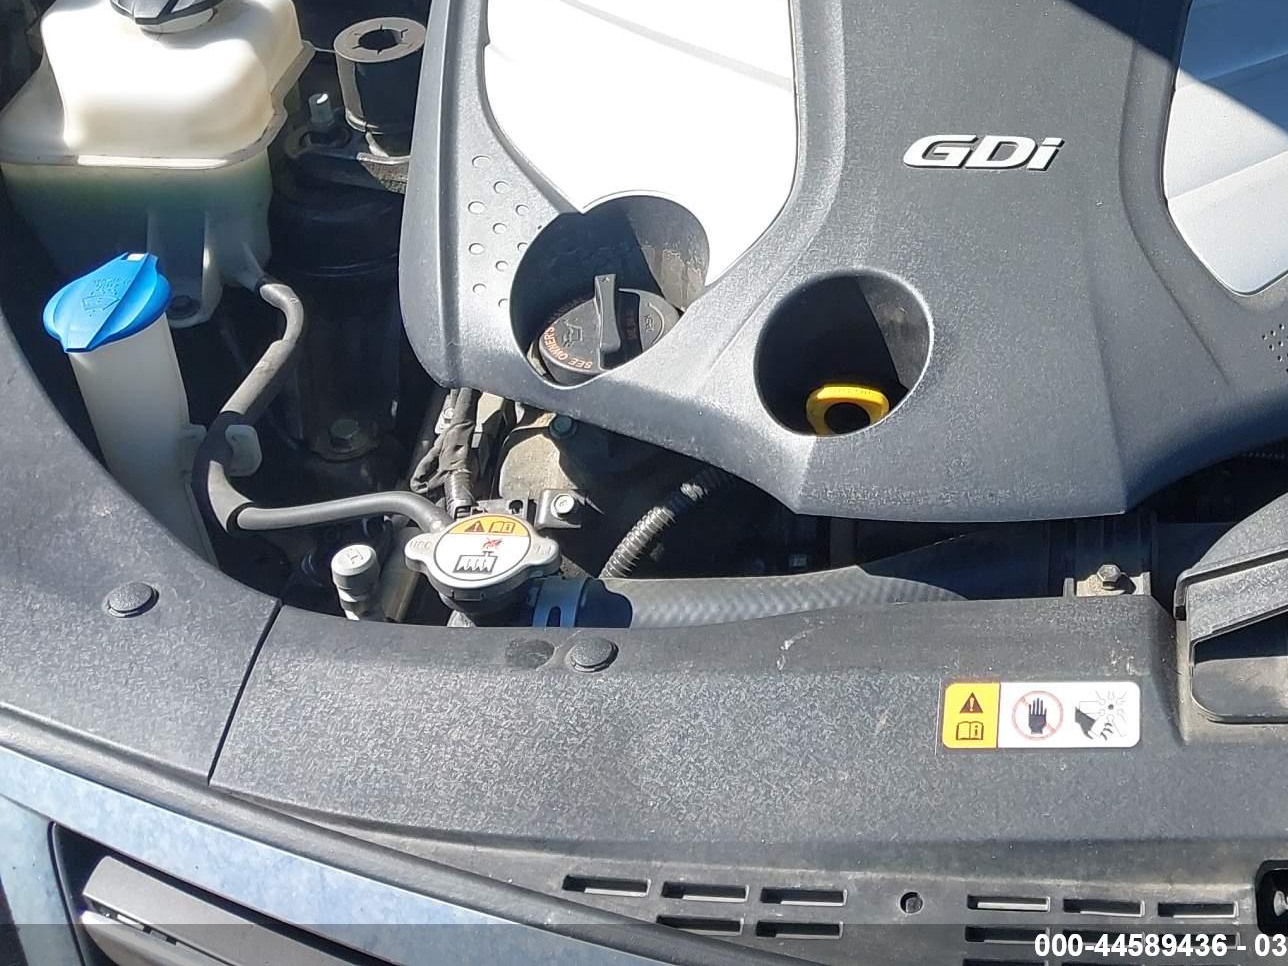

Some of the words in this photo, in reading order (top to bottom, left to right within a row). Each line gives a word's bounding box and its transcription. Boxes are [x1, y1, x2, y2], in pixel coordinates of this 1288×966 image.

[903, 134, 1065, 171] GDi
[543, 326, 569, 361] OWNERS
[567, 357, 593, 370] SEE
